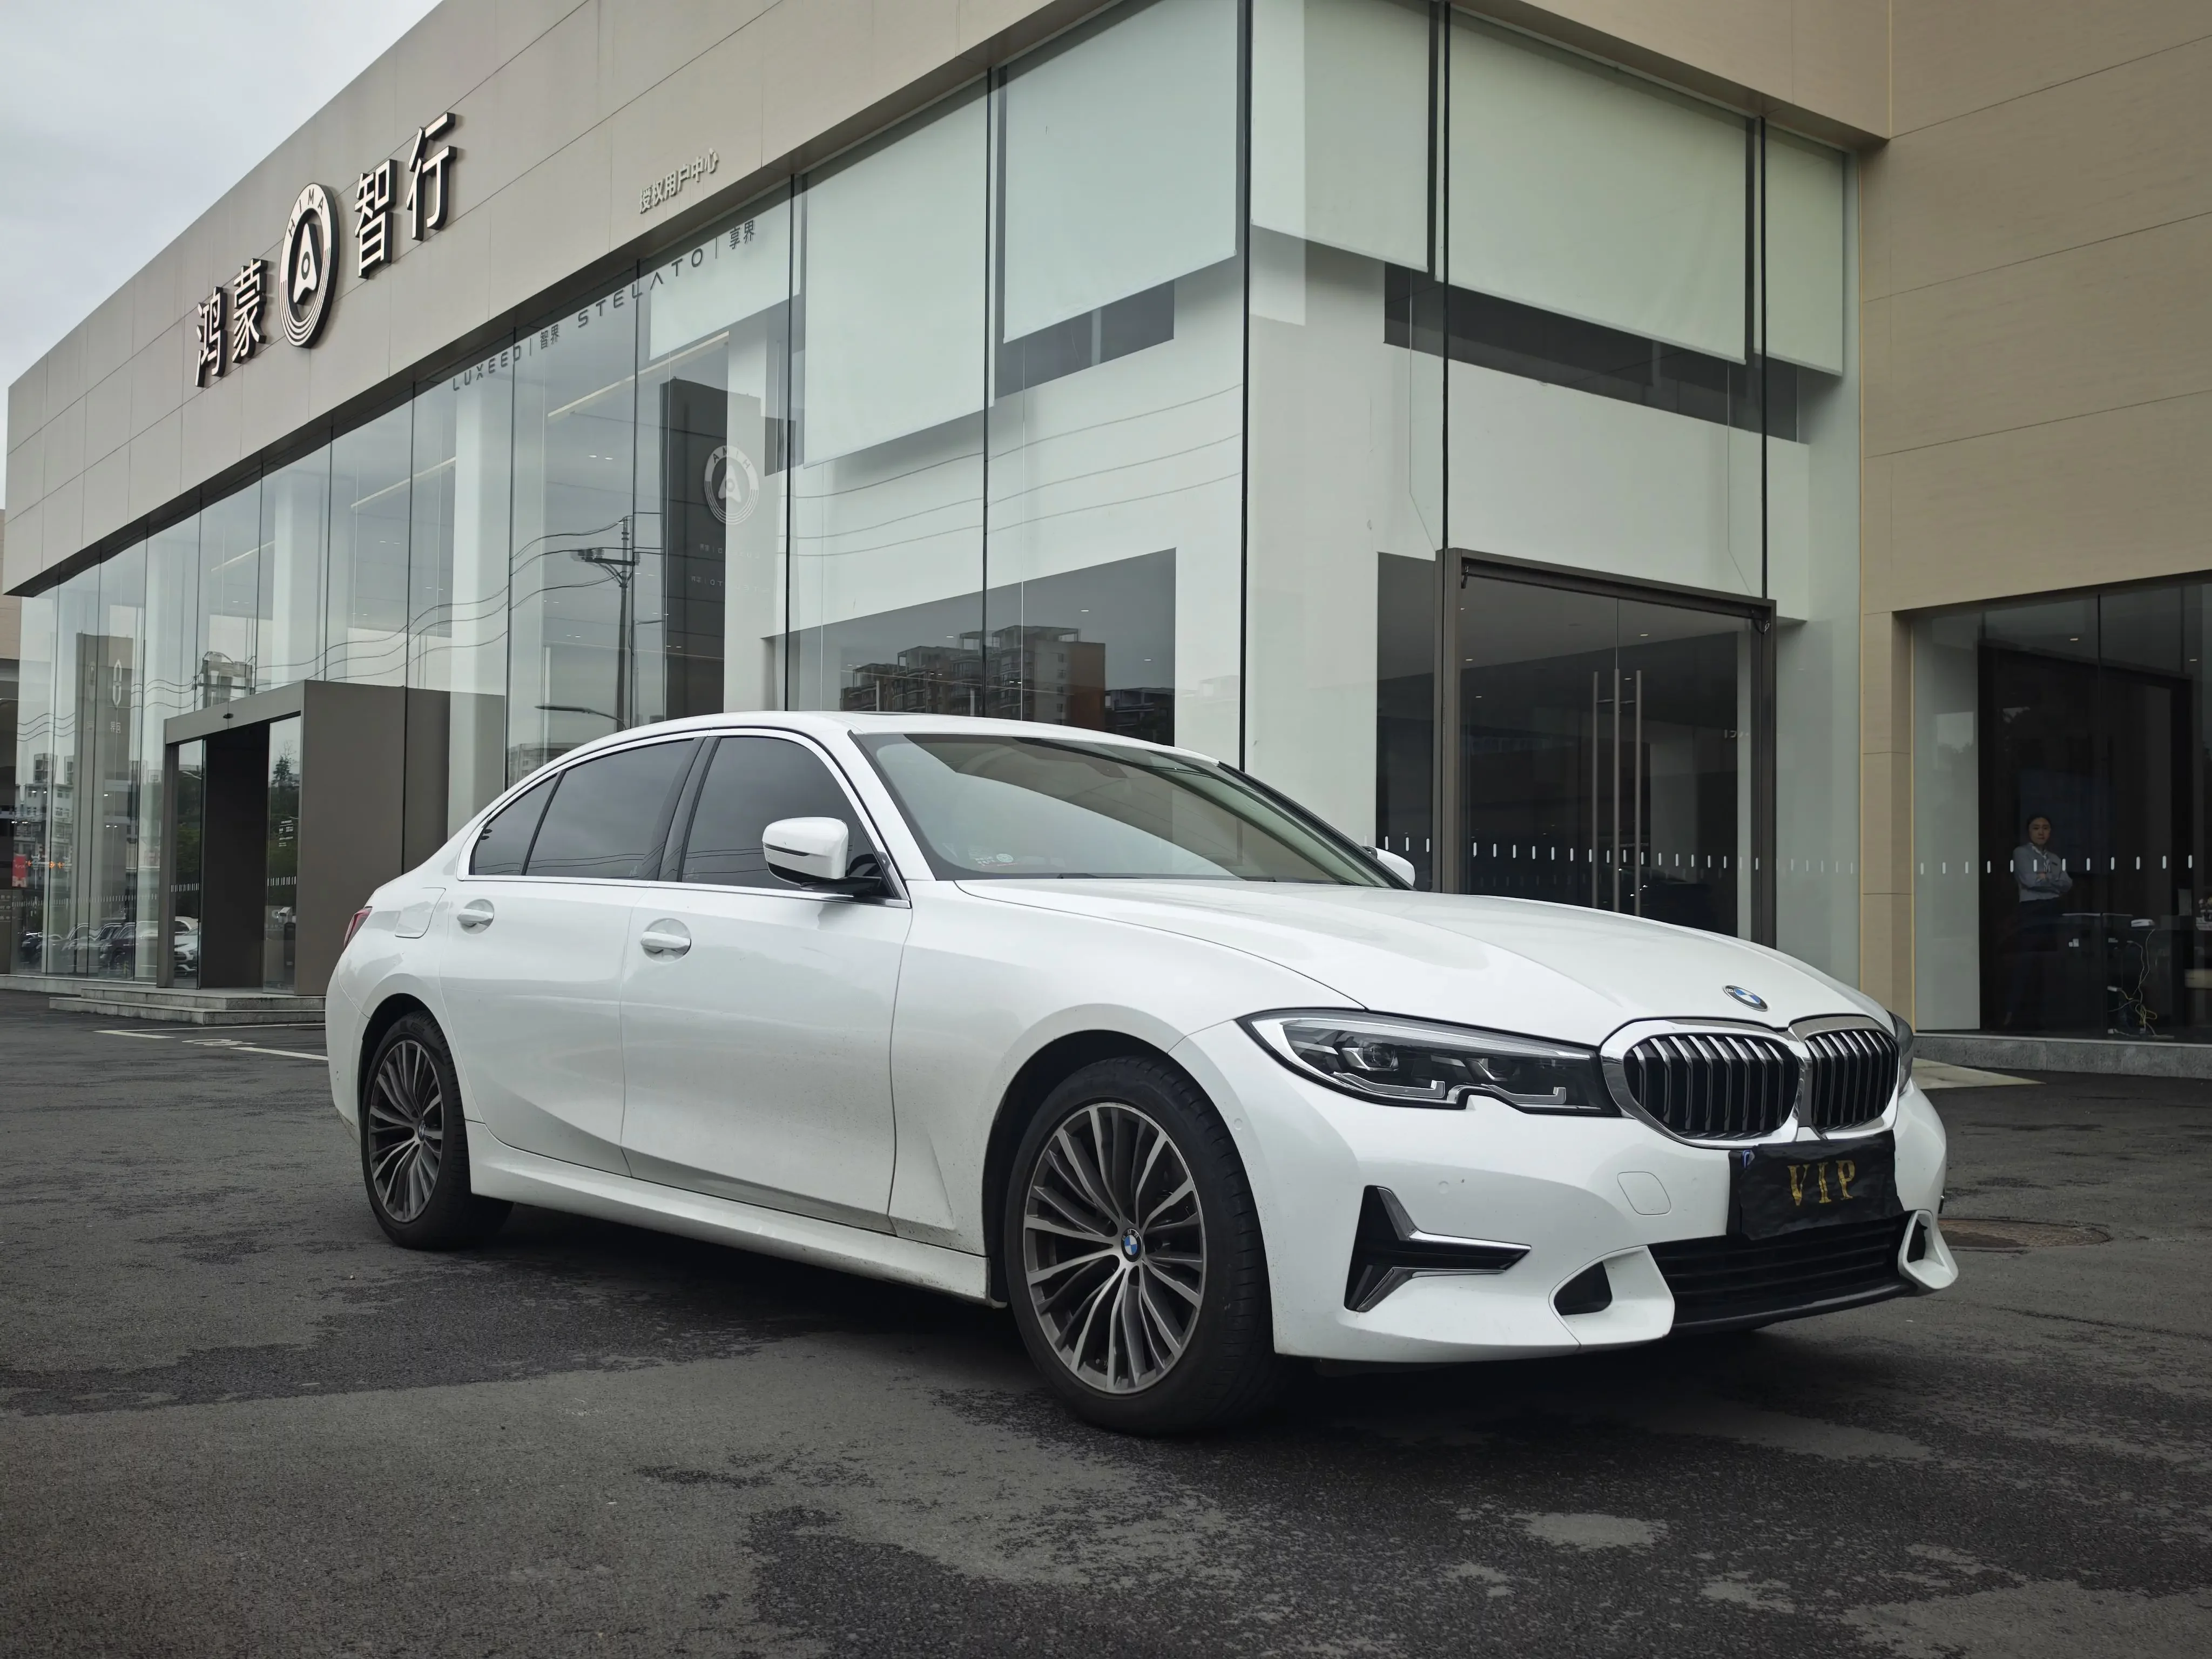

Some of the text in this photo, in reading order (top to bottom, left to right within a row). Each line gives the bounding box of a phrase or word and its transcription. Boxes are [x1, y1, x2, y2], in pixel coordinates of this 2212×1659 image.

[639, 147, 719, 214] 授权用户中心
[288, 188, 324, 238] HIMA
[729, 220, 756, 250] 享界
[195, 112, 457, 387] 鸿蒙 智行
[453, 323, 560, 392] LUXEED 智界
[1787, 1159, 1856, 1206] VIP
